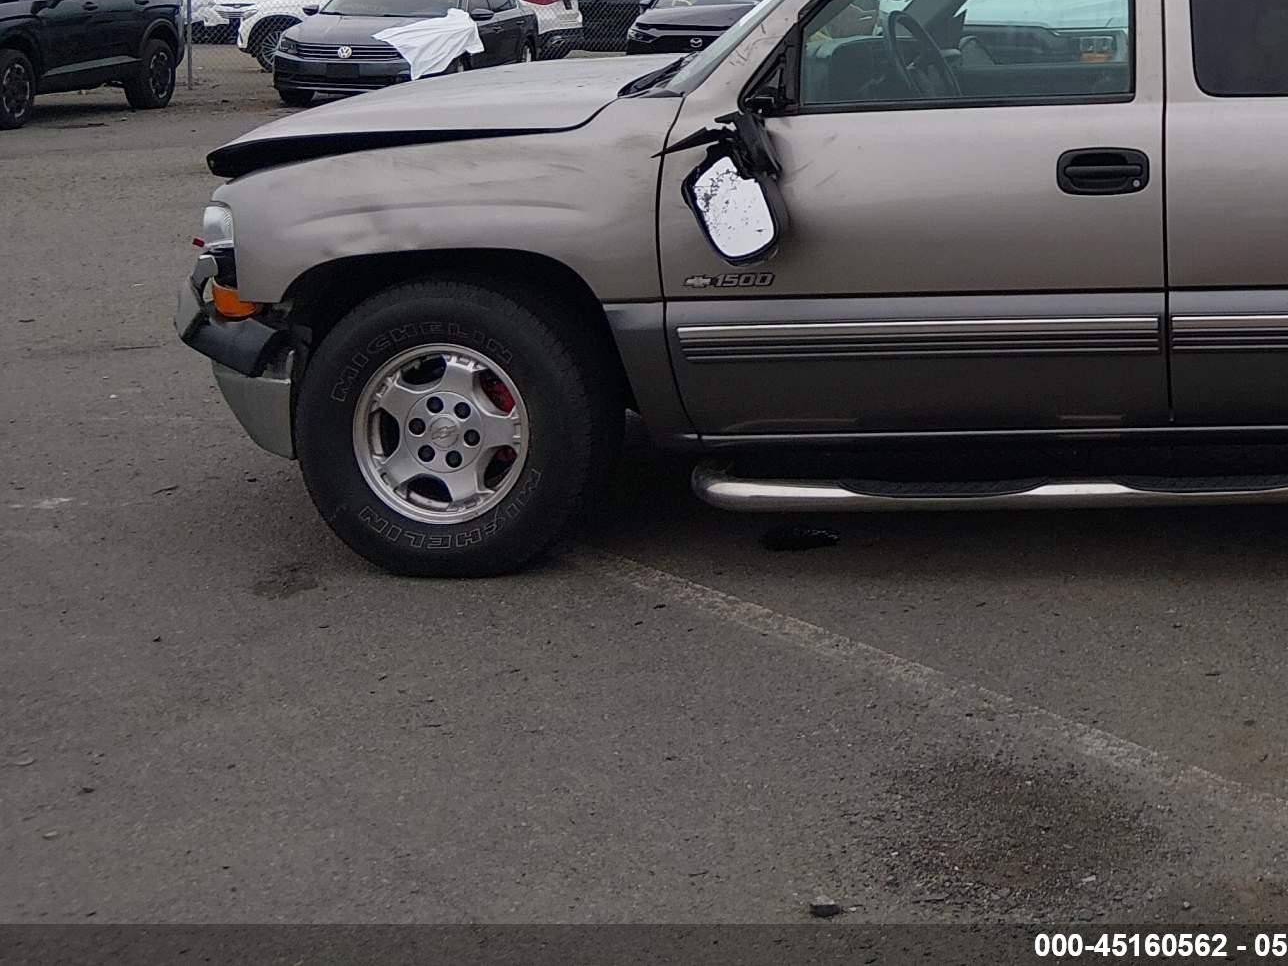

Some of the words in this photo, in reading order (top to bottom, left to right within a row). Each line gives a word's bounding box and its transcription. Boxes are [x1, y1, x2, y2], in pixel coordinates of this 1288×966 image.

[714, 273, 775, 287] 1500
[331, 322, 512, 401] MICHELIN
[359, 469, 541, 549] MICHELIN
